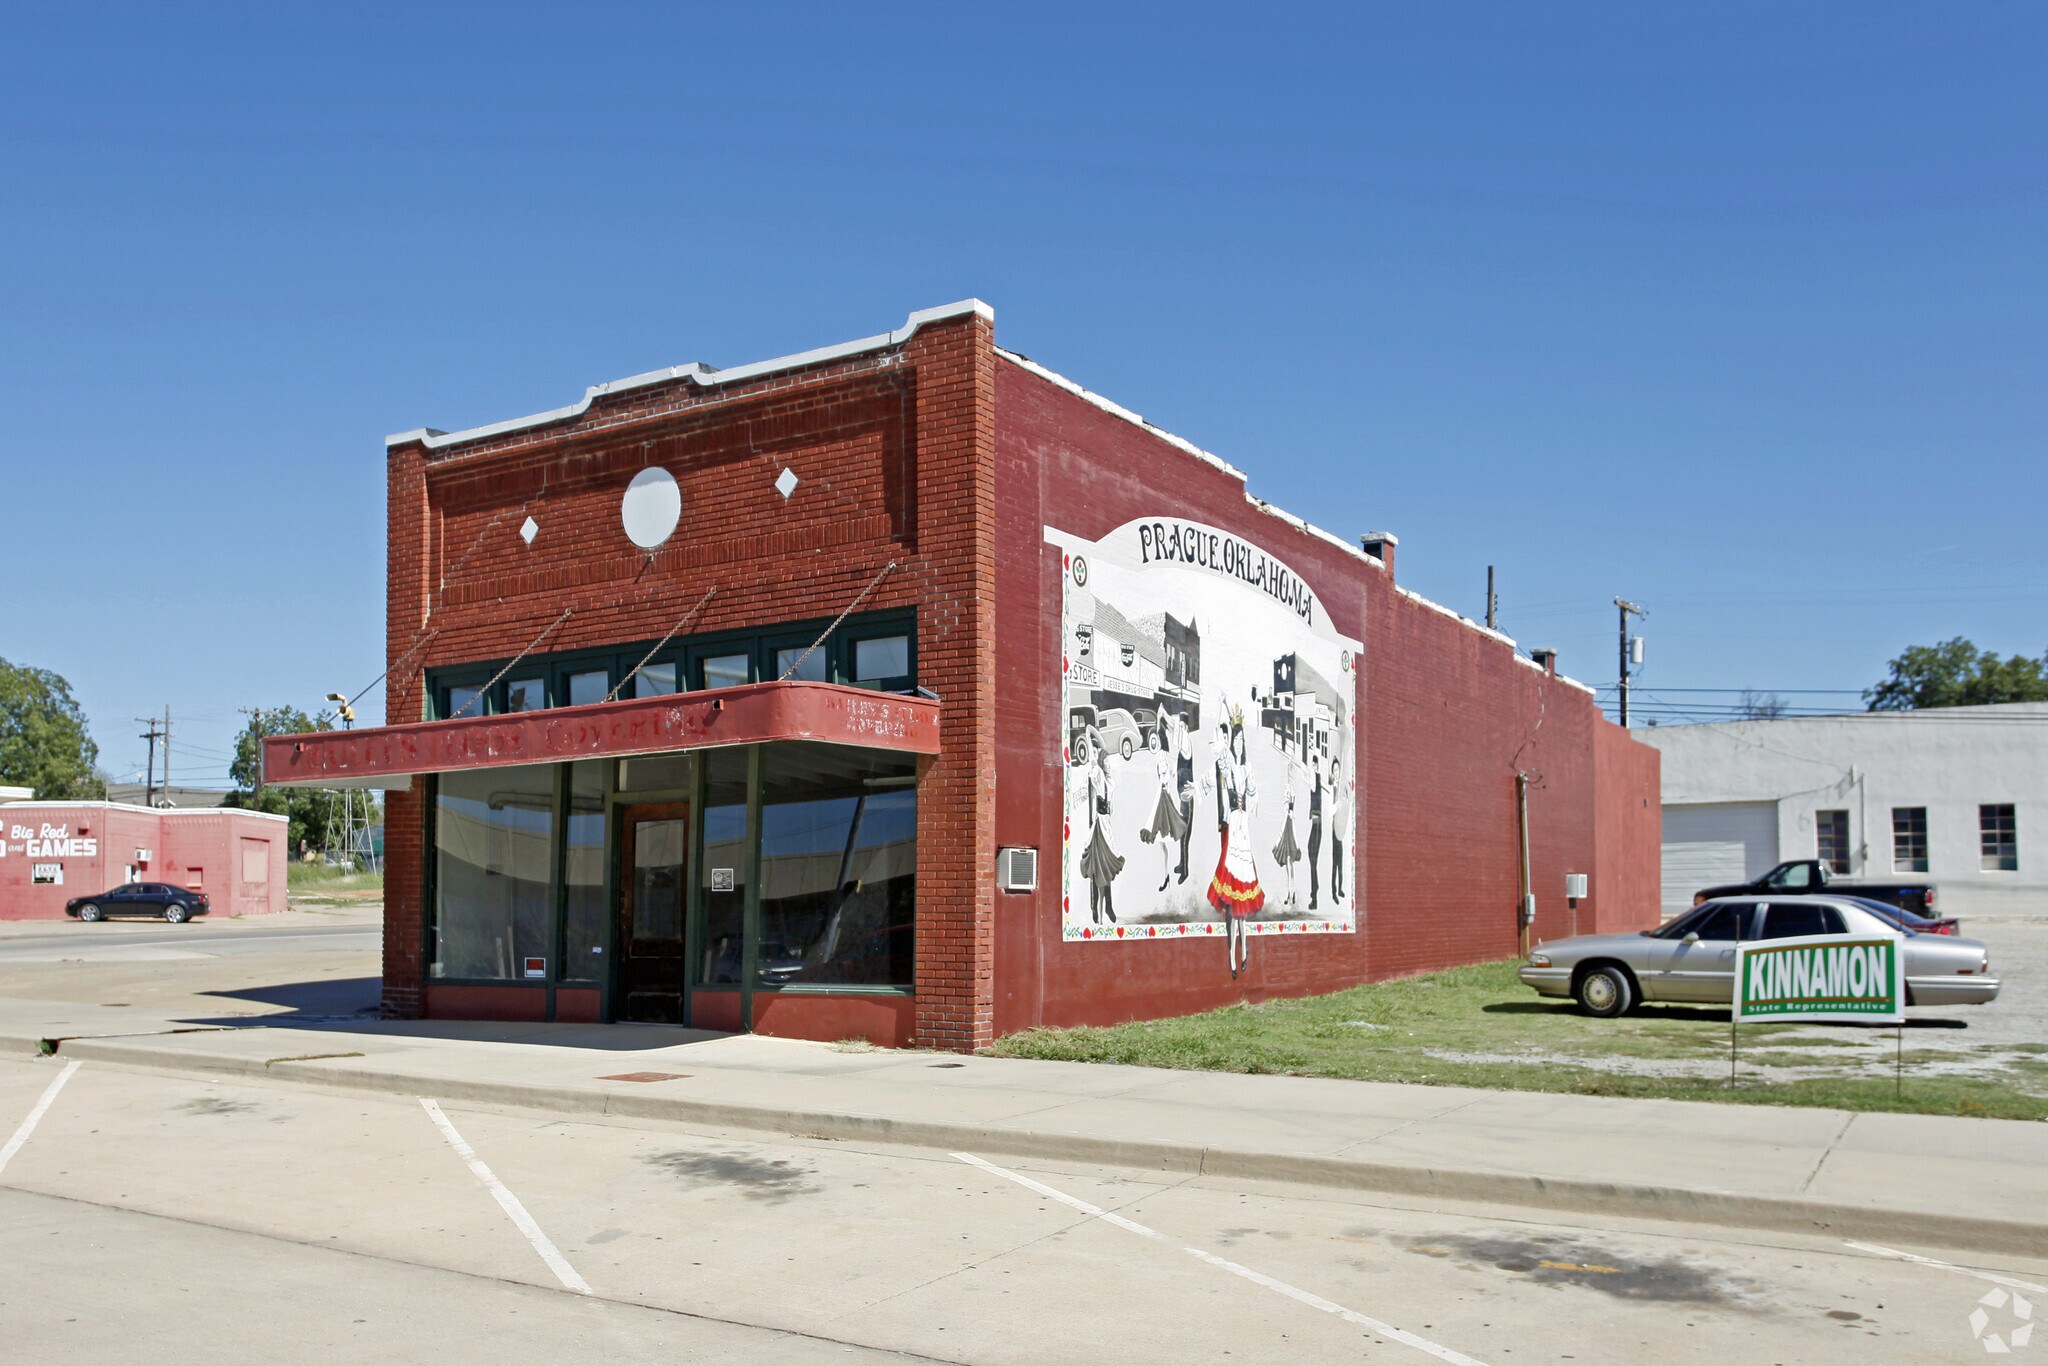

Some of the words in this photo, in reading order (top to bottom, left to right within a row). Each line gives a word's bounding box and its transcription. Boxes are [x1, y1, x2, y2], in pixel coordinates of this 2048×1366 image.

[11, 824, 34, 839] Big
[39, 822, 70, 839] Red
[26, 838, 97, 857] GAMES
[1748, 945, 1887, 1001] KINNAMON
[1748, 1003, 1781, 1013] State
[1786, 1002, 1887, 1011] Representative
